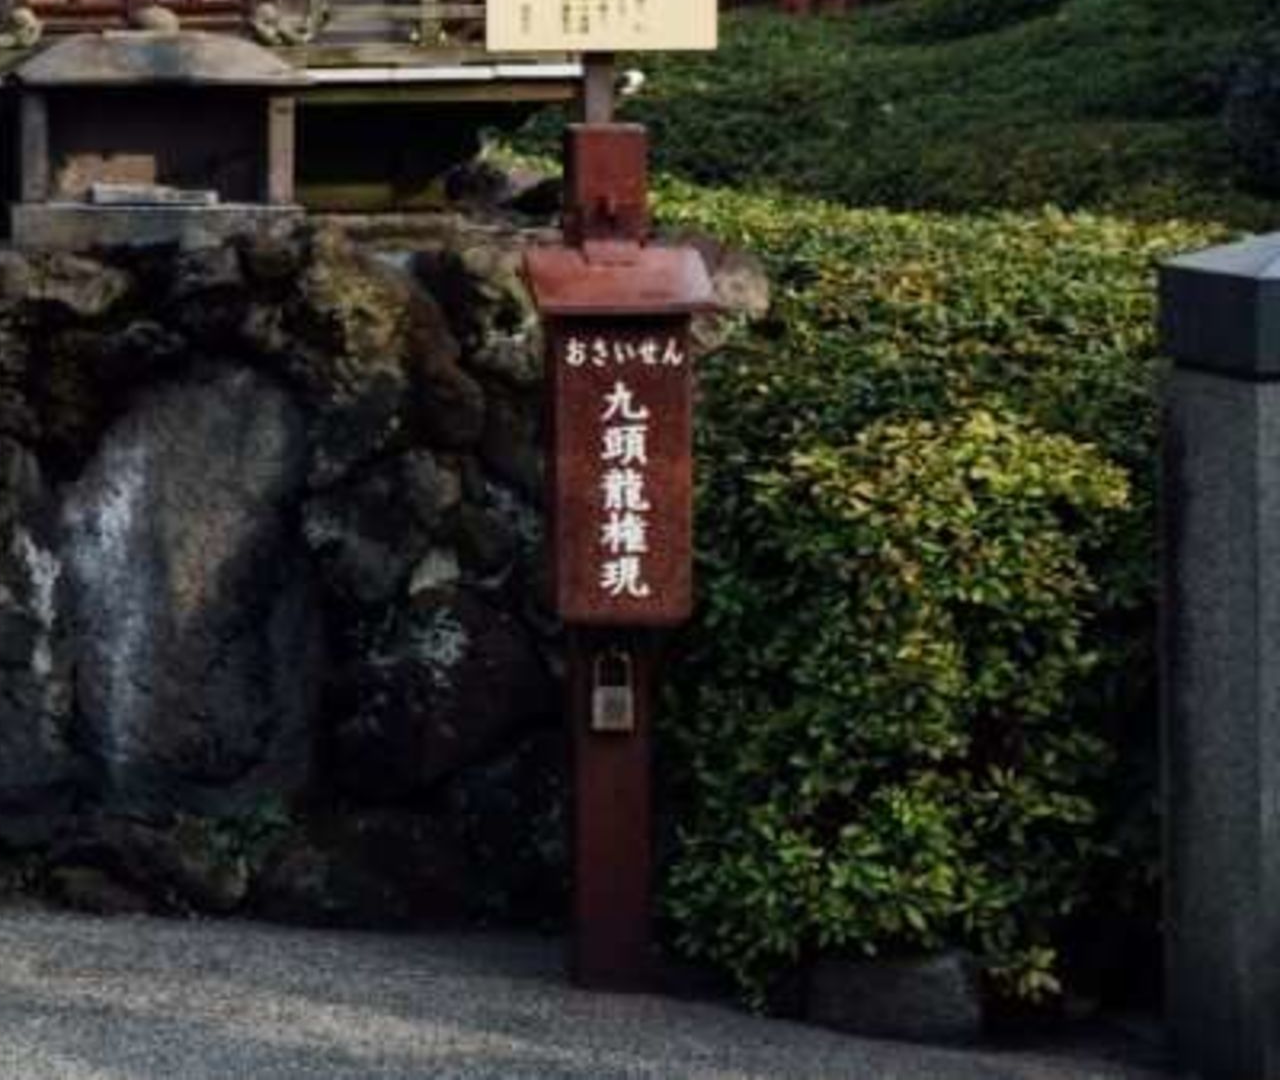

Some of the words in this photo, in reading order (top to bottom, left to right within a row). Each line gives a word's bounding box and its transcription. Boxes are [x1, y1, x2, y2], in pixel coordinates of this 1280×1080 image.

[565, 337, 684, 366] おさいせん
[599, 380, 652, 597] 九頭龍権現
